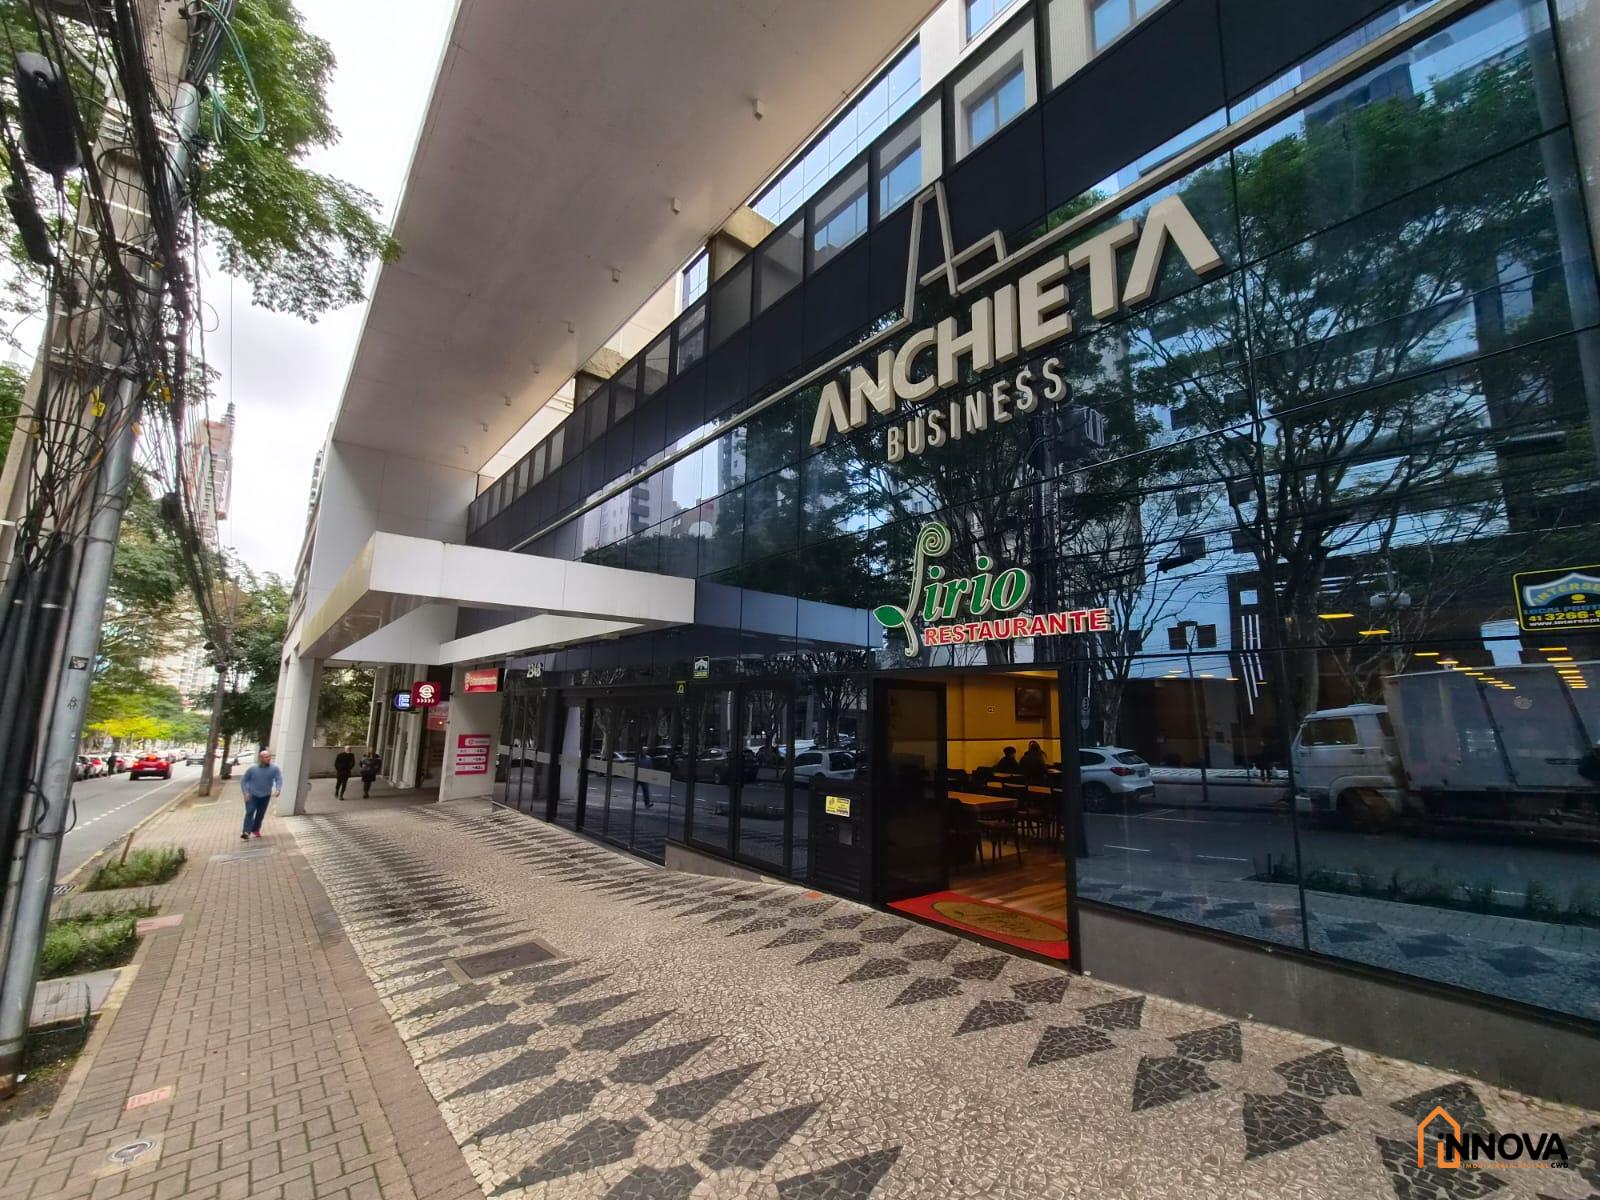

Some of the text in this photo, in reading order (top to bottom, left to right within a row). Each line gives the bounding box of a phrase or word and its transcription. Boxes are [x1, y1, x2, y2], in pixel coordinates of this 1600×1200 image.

[810, 194, 1225, 448] ANCHIETA
[887, 356, 1067, 463] BUSINESS
[924, 607, 1112, 647] RESTAURANTE
